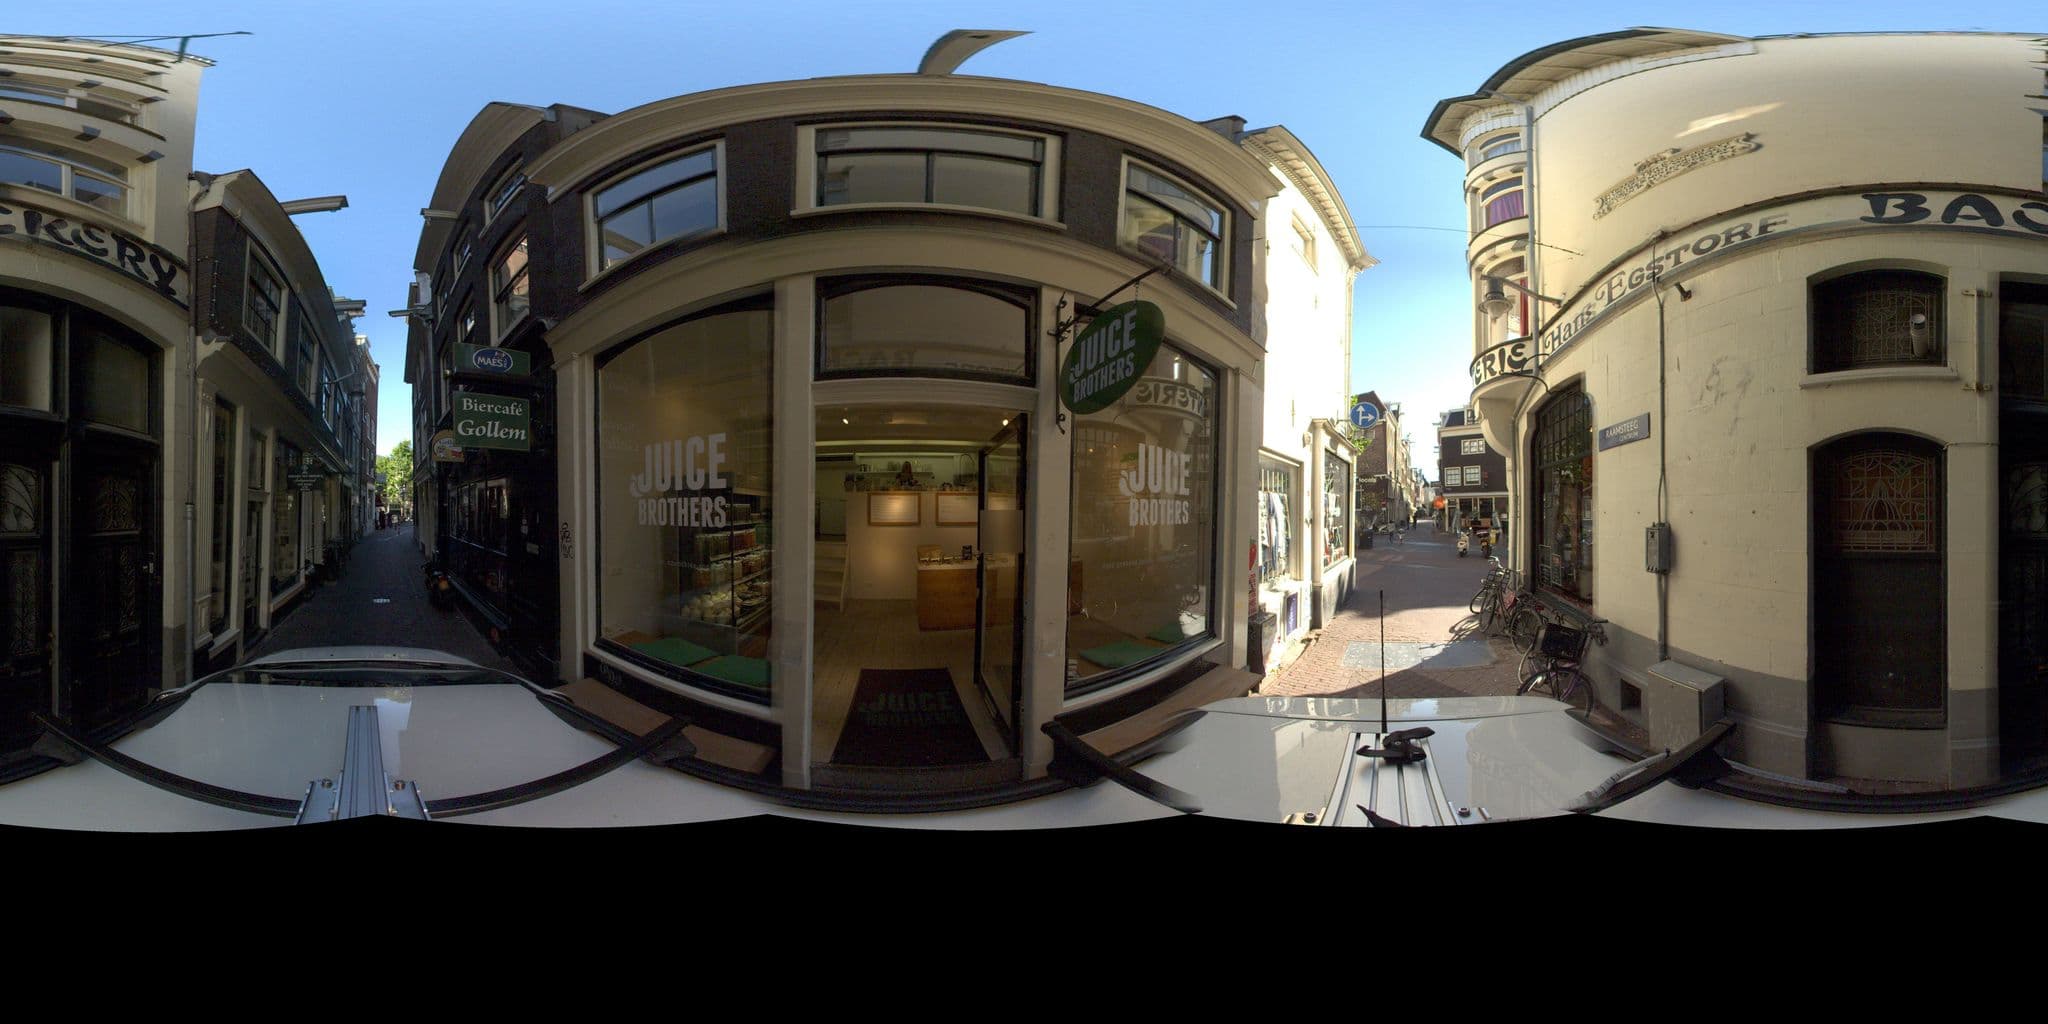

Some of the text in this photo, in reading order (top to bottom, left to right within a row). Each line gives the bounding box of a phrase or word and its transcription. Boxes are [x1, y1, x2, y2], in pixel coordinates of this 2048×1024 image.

[1545, 213, 1789, 352] Hans EGSTORF
[477, 356, 504, 368] MAES
[1073, 309, 1136, 377] JUICE
[1472, 343, 1530, 386] ERIE
[1073, 352, 1136, 403] BROTHERS
[462, 398, 523, 416] Biercafé
[457, 420, 527, 440] Gollem
[637, 433, 727, 494] JUICE
[638, 496, 726, 529] BROTHERS
